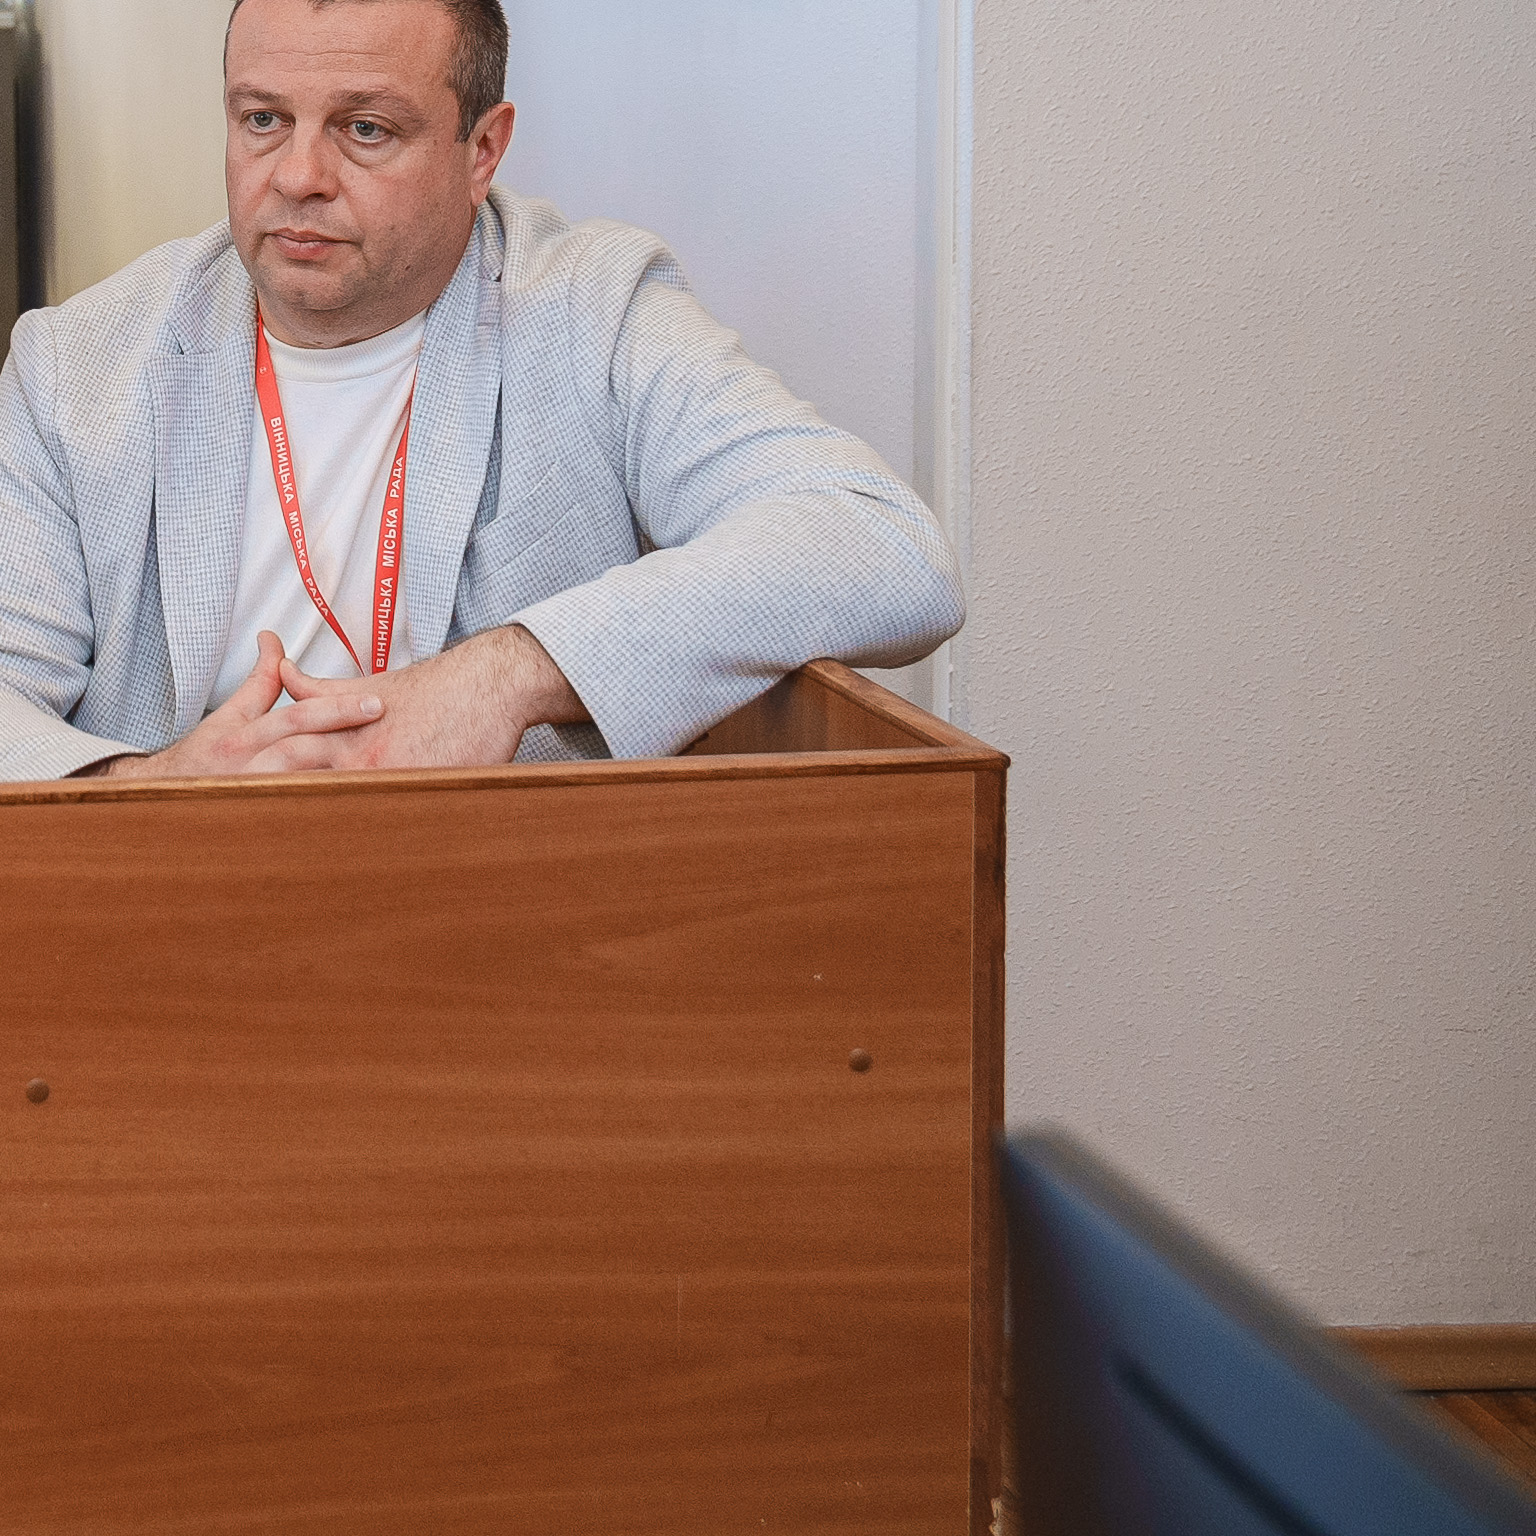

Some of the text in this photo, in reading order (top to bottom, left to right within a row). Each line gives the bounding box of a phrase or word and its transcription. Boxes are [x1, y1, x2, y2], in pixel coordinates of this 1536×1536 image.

[270, 416, 329, 617] ВІННИЦЬКА МІСЬКА РАДА
[375, 456, 404, 668] ВІННИЦЬКА МІСЬКА РАДА
